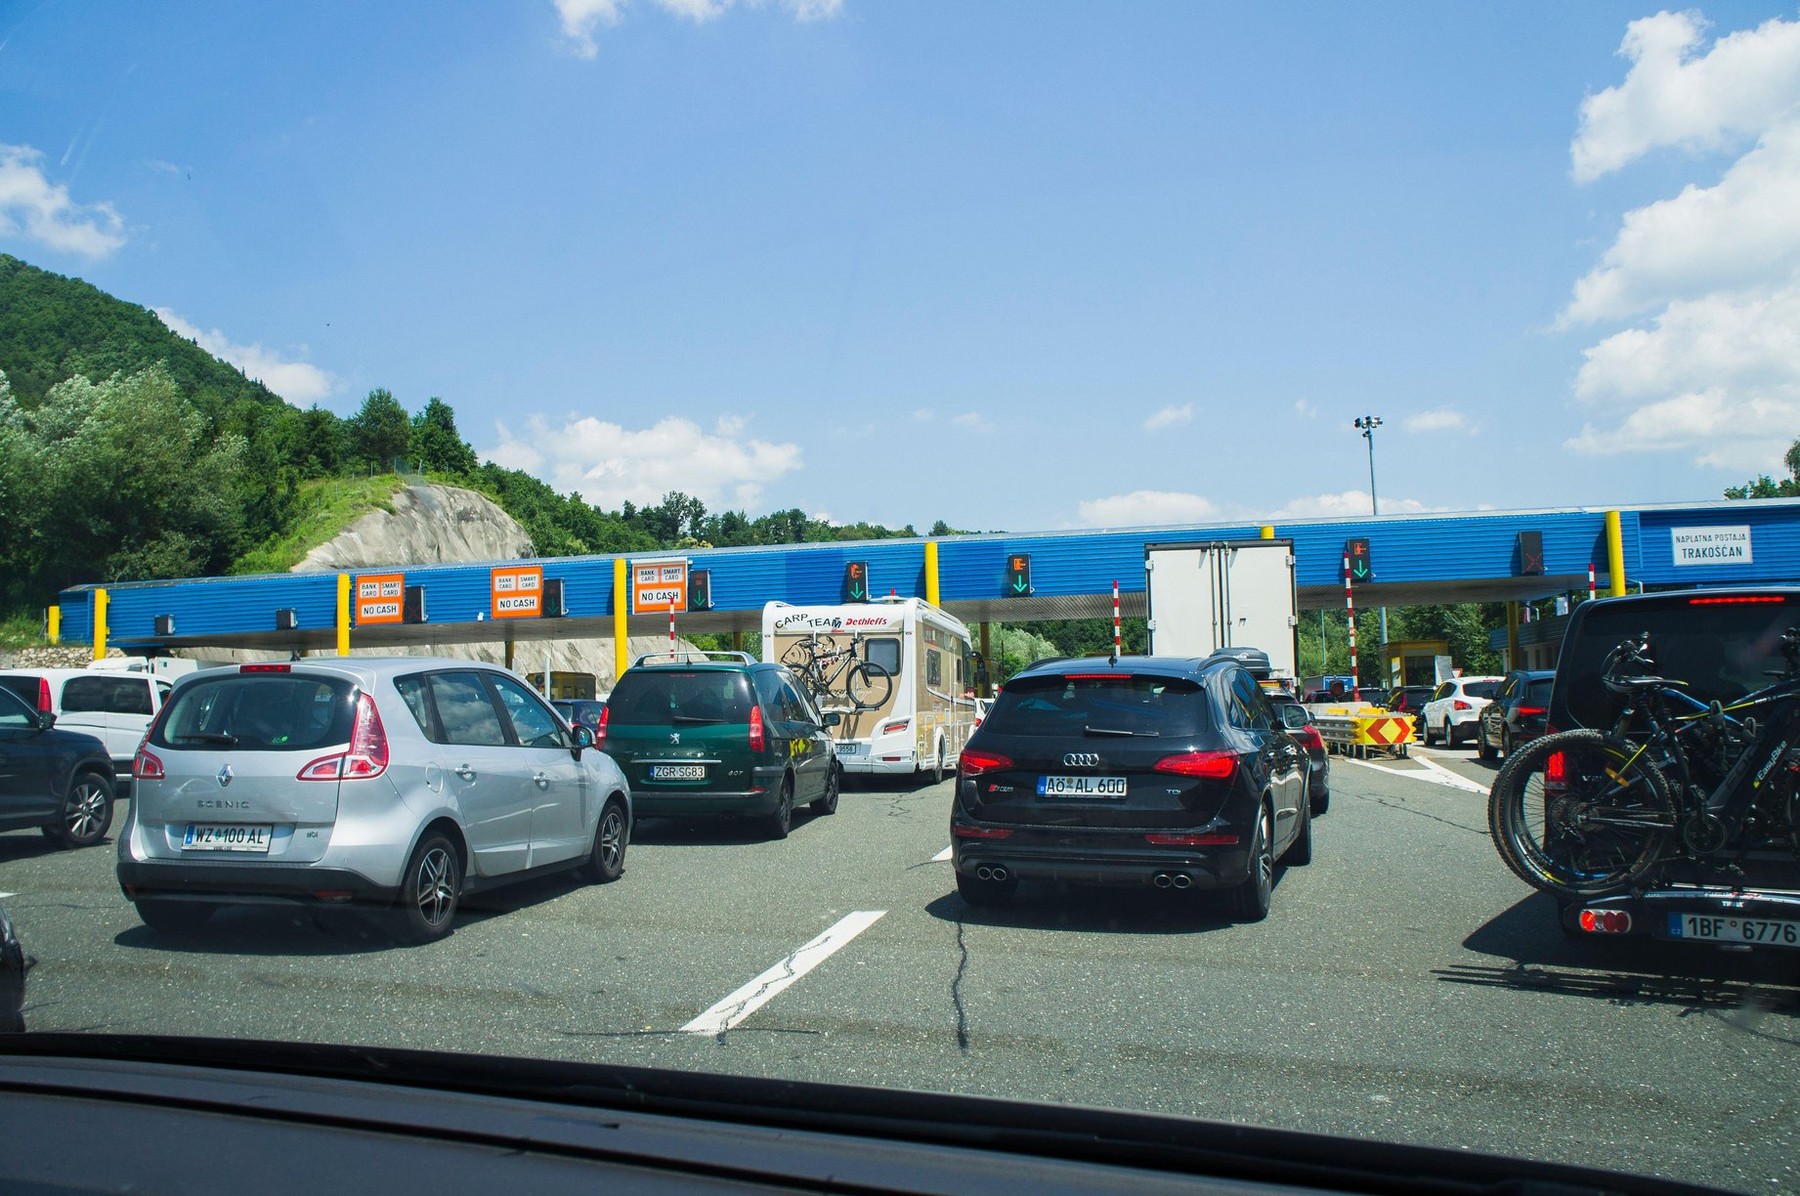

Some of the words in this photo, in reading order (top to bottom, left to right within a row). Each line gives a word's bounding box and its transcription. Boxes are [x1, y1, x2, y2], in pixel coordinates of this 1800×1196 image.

[1675, 534, 1713, 544] NAPLATNA
[1714, 533, 1746, 542] POSTAJA
[1681, 544, 1743, 559] TRAKOŠĆAN
[641, 592, 654, 601] NO
[656, 591, 679, 601] CASH
[499, 600, 512, 609] NO
[513, 598, 535, 608] CASH
[363, 606, 375, 615] NO
[376, 605, 397, 614] CASH
[775, 613, 809, 629] CARP
[807, 617, 842, 629] TEAM
[845, 617, 888, 626] Dethleffs
[655, 767, 676, 777] ZGR
[678, 767, 704, 777] SG83
[1046, 778, 1066, 793] AÖ
[1074, 778, 1094, 793] AL
[1097, 779, 1125, 794] 600
[196, 800, 250, 809] SCENIC
[196, 828, 212, 843] WZ
[223, 828, 245, 844] 100
[247, 829, 264, 844] AL
[1687, 917, 1725, 938] 1BF
[1742, 921, 1797, 943] 6776
